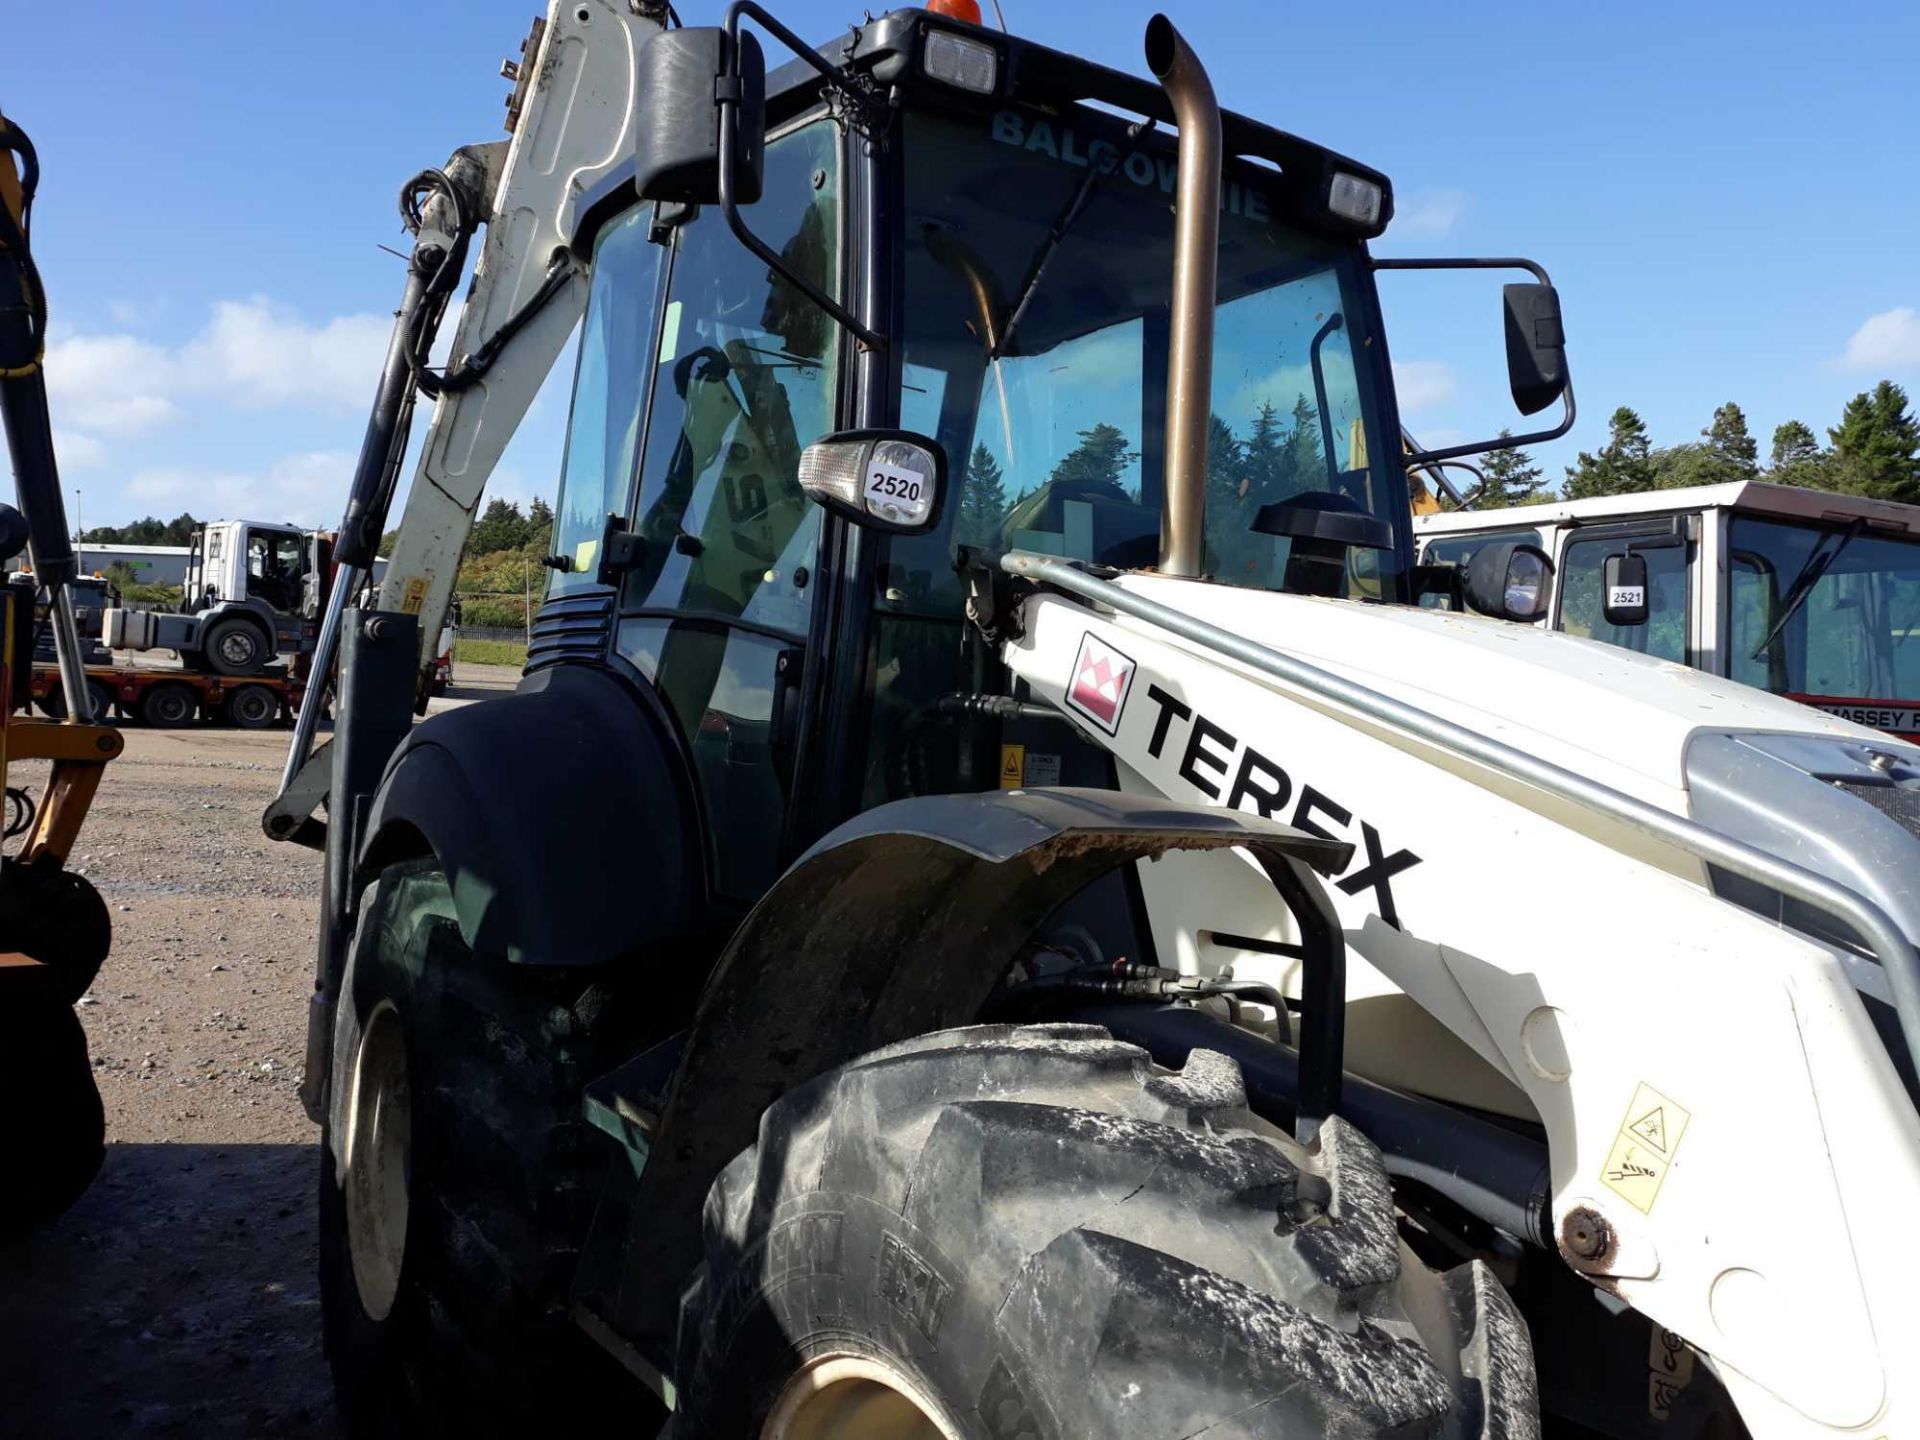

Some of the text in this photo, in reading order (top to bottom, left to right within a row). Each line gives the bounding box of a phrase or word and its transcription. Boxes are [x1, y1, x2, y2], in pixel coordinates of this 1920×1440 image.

[870, 473, 920, 502] 2520
[1613, 592, 1641, 603] 2521
[1148, 683, 1424, 933] TEREX
